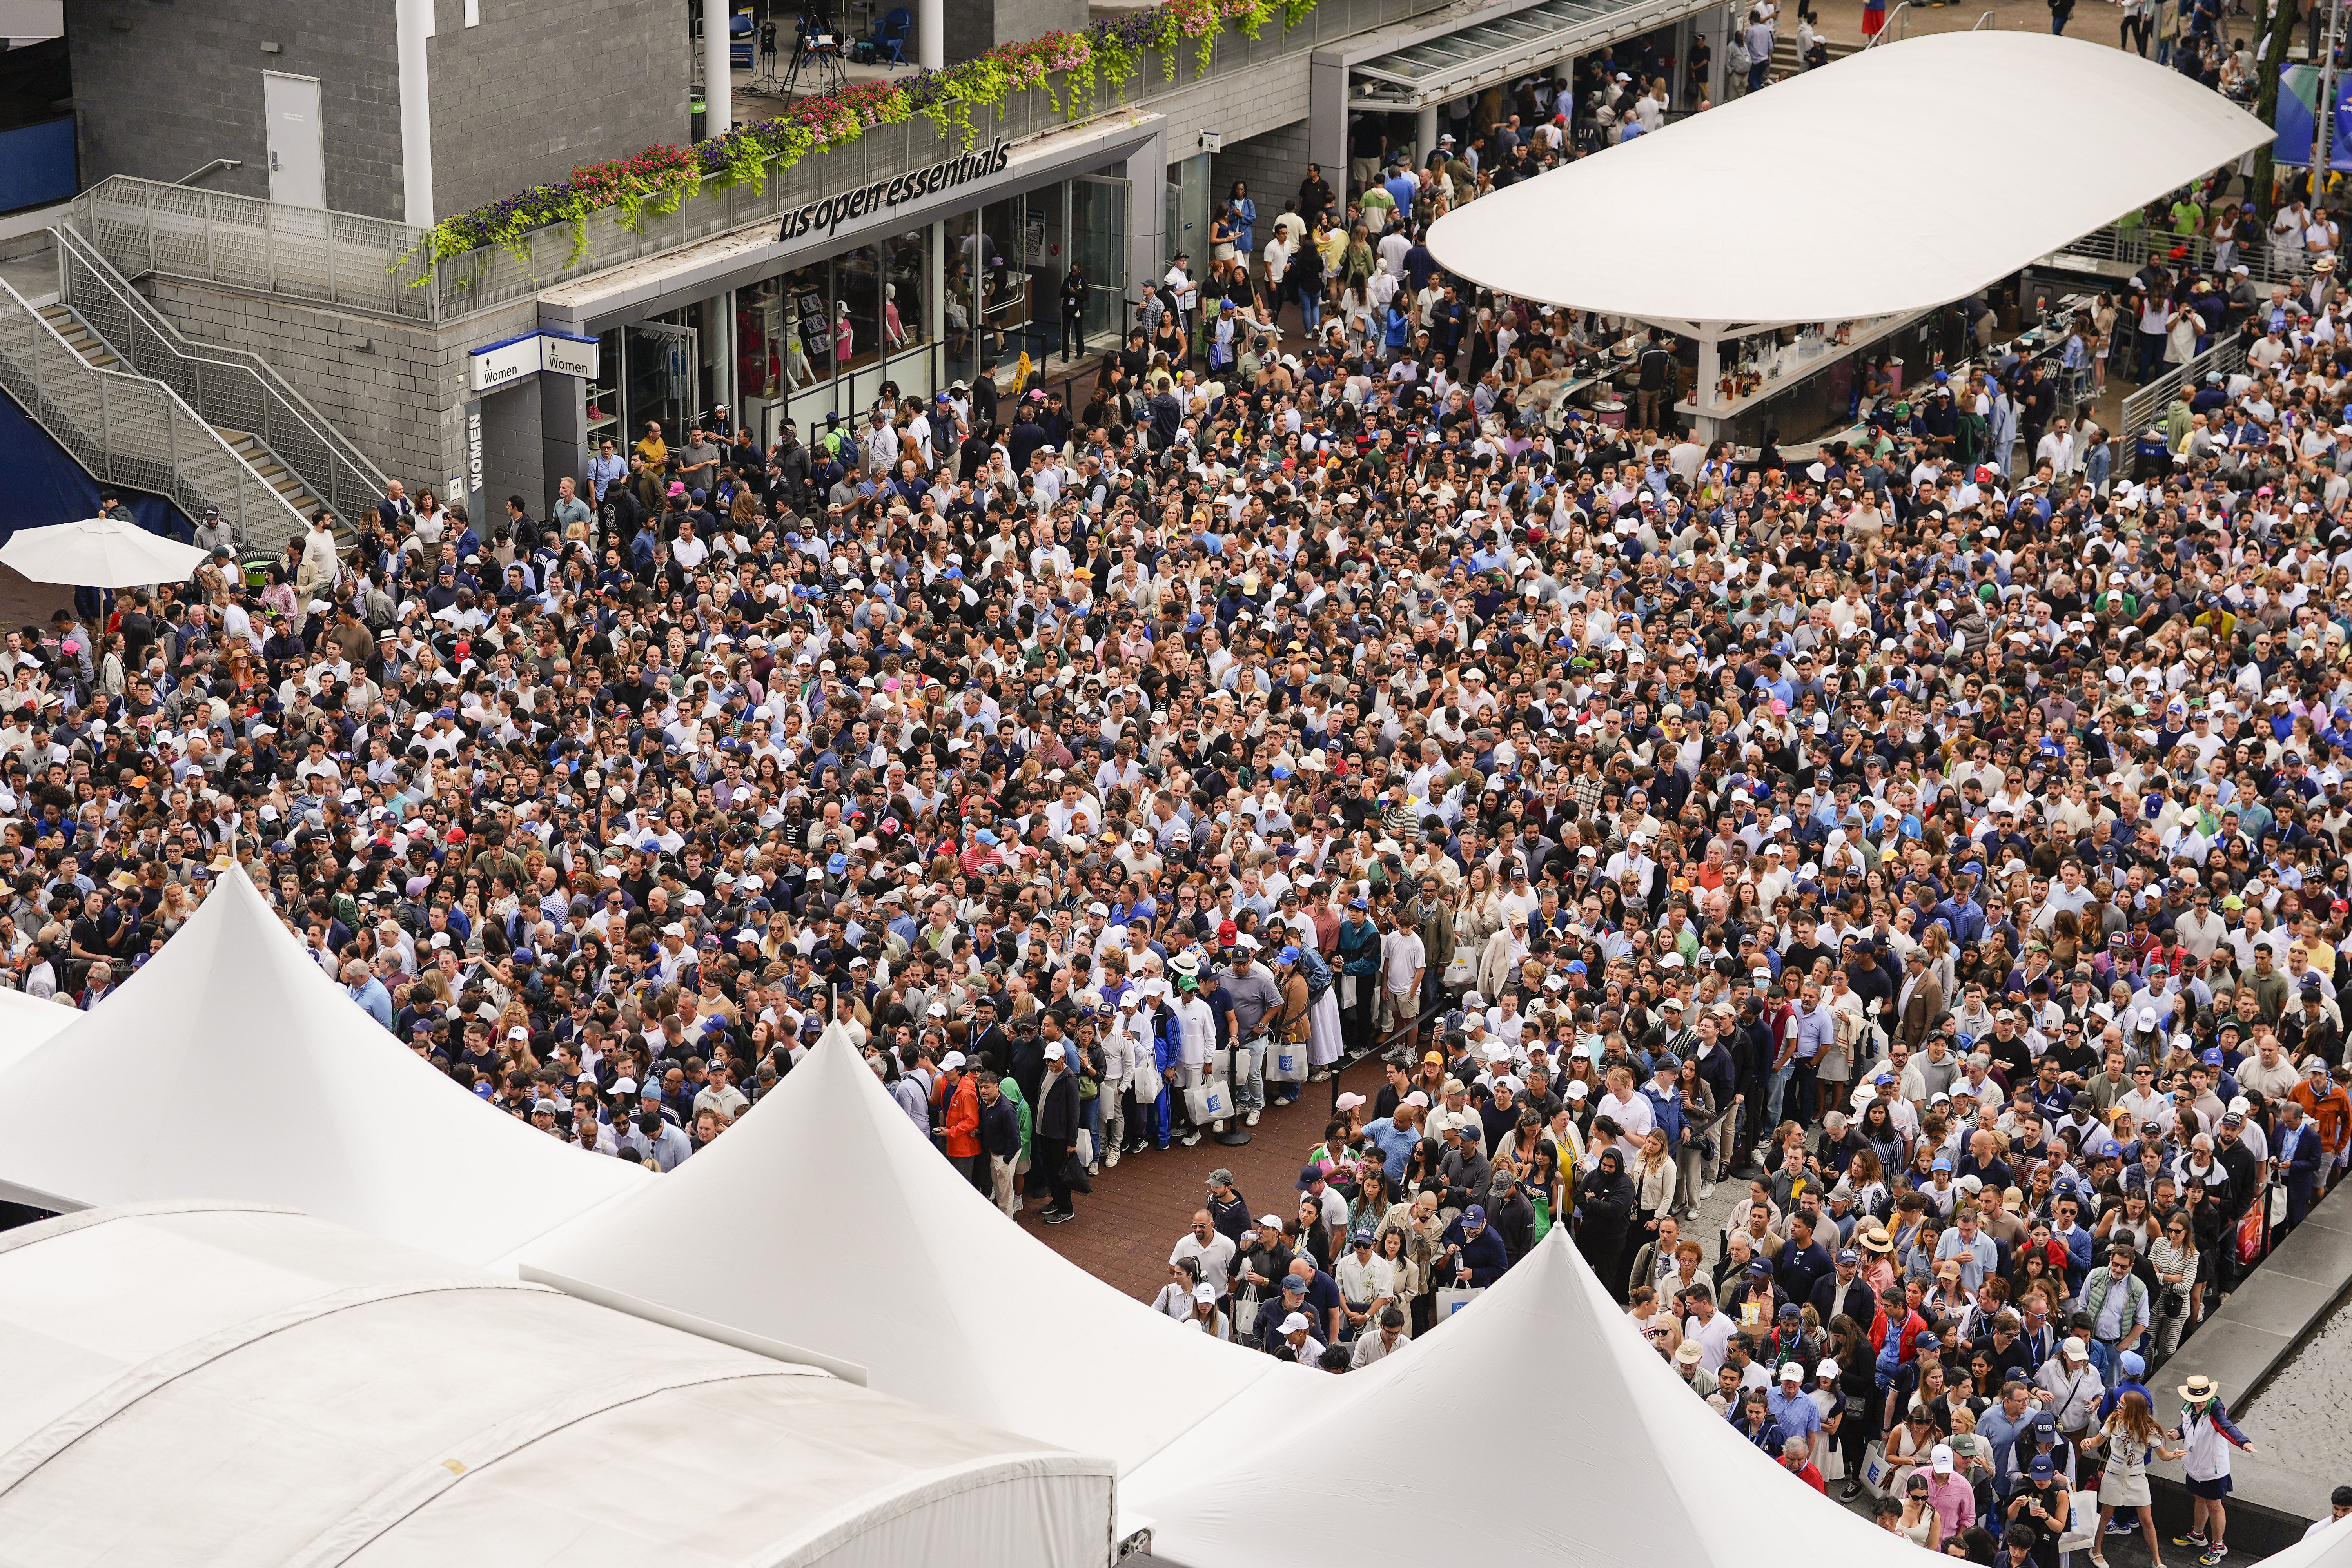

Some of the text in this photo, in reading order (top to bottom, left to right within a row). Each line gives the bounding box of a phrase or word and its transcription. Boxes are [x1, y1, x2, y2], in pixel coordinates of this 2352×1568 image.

[1578, 129, 1594, 138] GAP
[778, 135, 1011, 241] us open essentials
[549, 356, 588, 374] Women
[484, 365, 517, 384] Women
[469, 414, 483, 493] WOMEN
[533, 553, 548, 568] US OPEN
